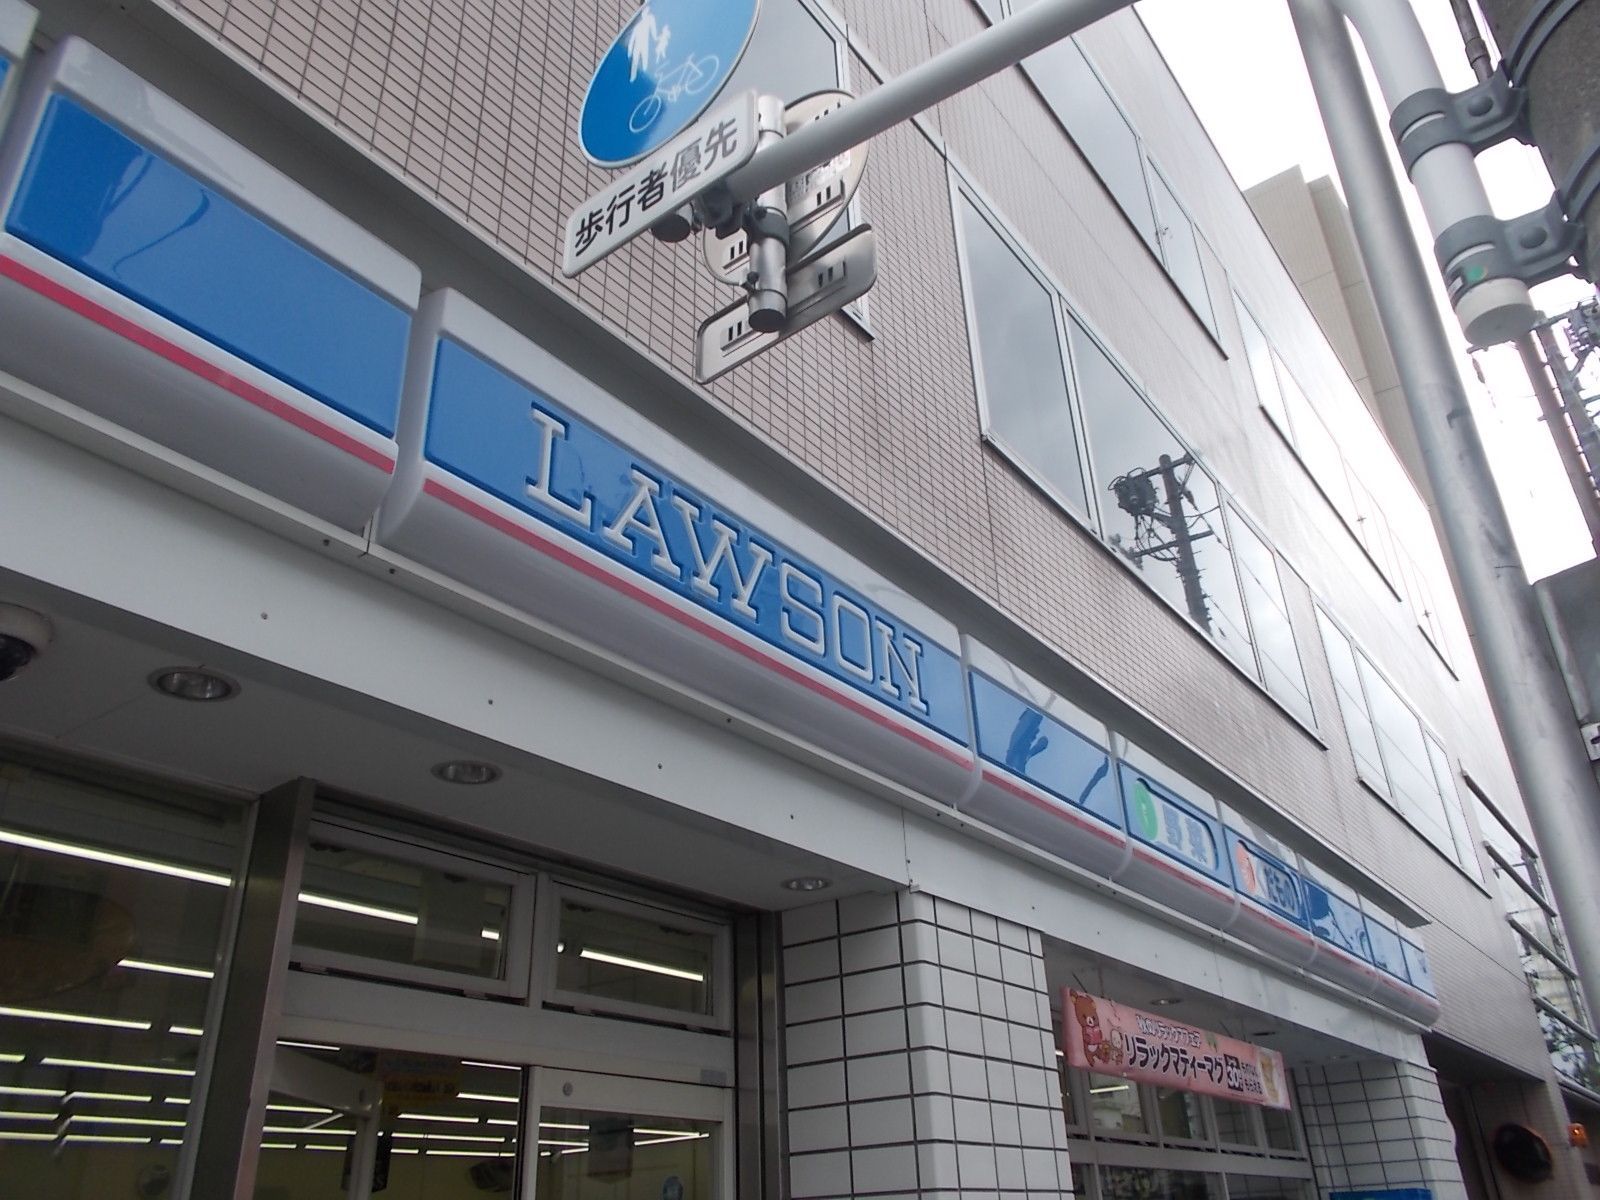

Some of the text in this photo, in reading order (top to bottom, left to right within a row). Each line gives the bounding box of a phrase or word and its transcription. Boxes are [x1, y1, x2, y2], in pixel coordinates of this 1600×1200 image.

[575, 115, 738, 257] 歩行者優先
[524, 403, 929, 715] LAWSON
[1125, 1033, 1224, 1085] リラックマティーマグ
